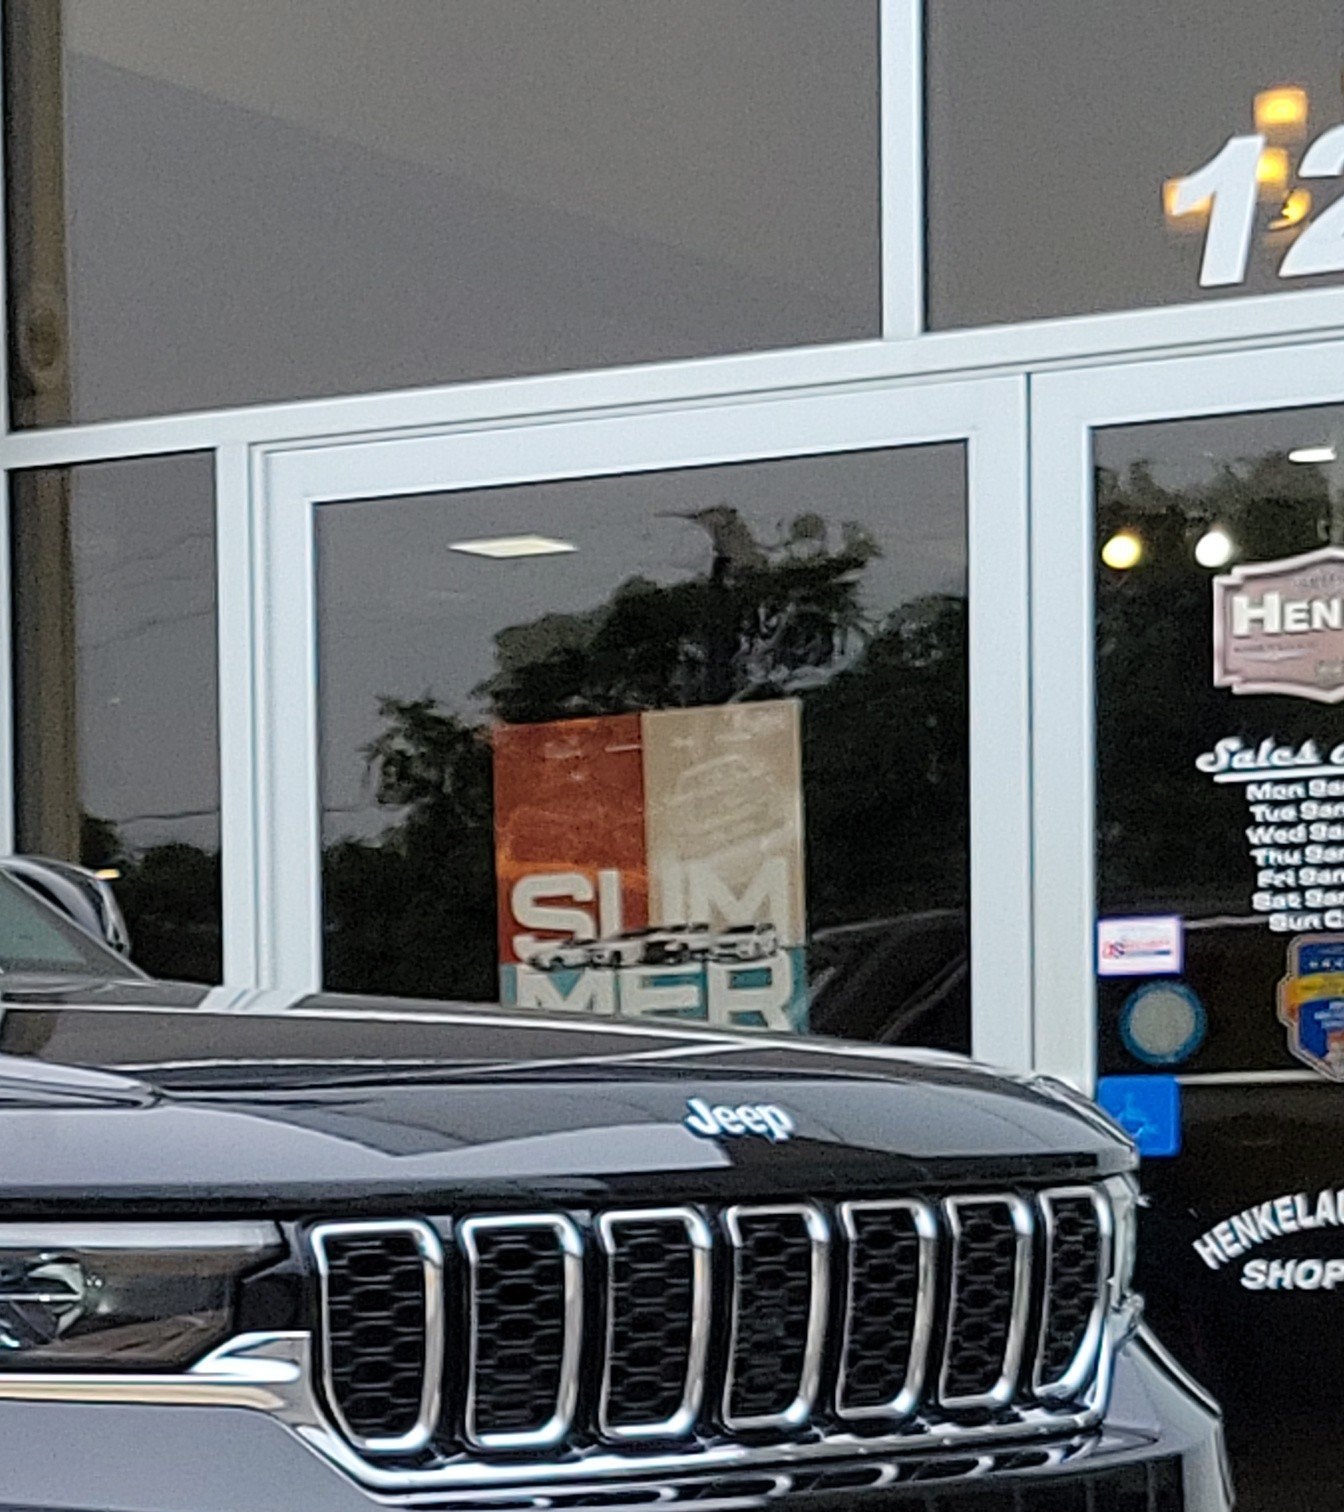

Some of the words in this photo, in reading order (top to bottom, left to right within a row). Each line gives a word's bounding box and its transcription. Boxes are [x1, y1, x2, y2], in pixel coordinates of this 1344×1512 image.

[1195, 736, 1323, 772] Sales
[1246, 781, 1307, 802] Mon
[1249, 803, 1299, 823] Tue
[1245, 823, 1307, 844] Wed
[1249, 847, 1303, 867] Thu
[1257, 867, 1297, 888] Fri
[1252, 890, 1303, 912] Sat
[1269, 911, 1323, 932] Sun
[685, 1098, 794, 1143] Jeep
[1240, 1258, 1344, 1290] SHOP
